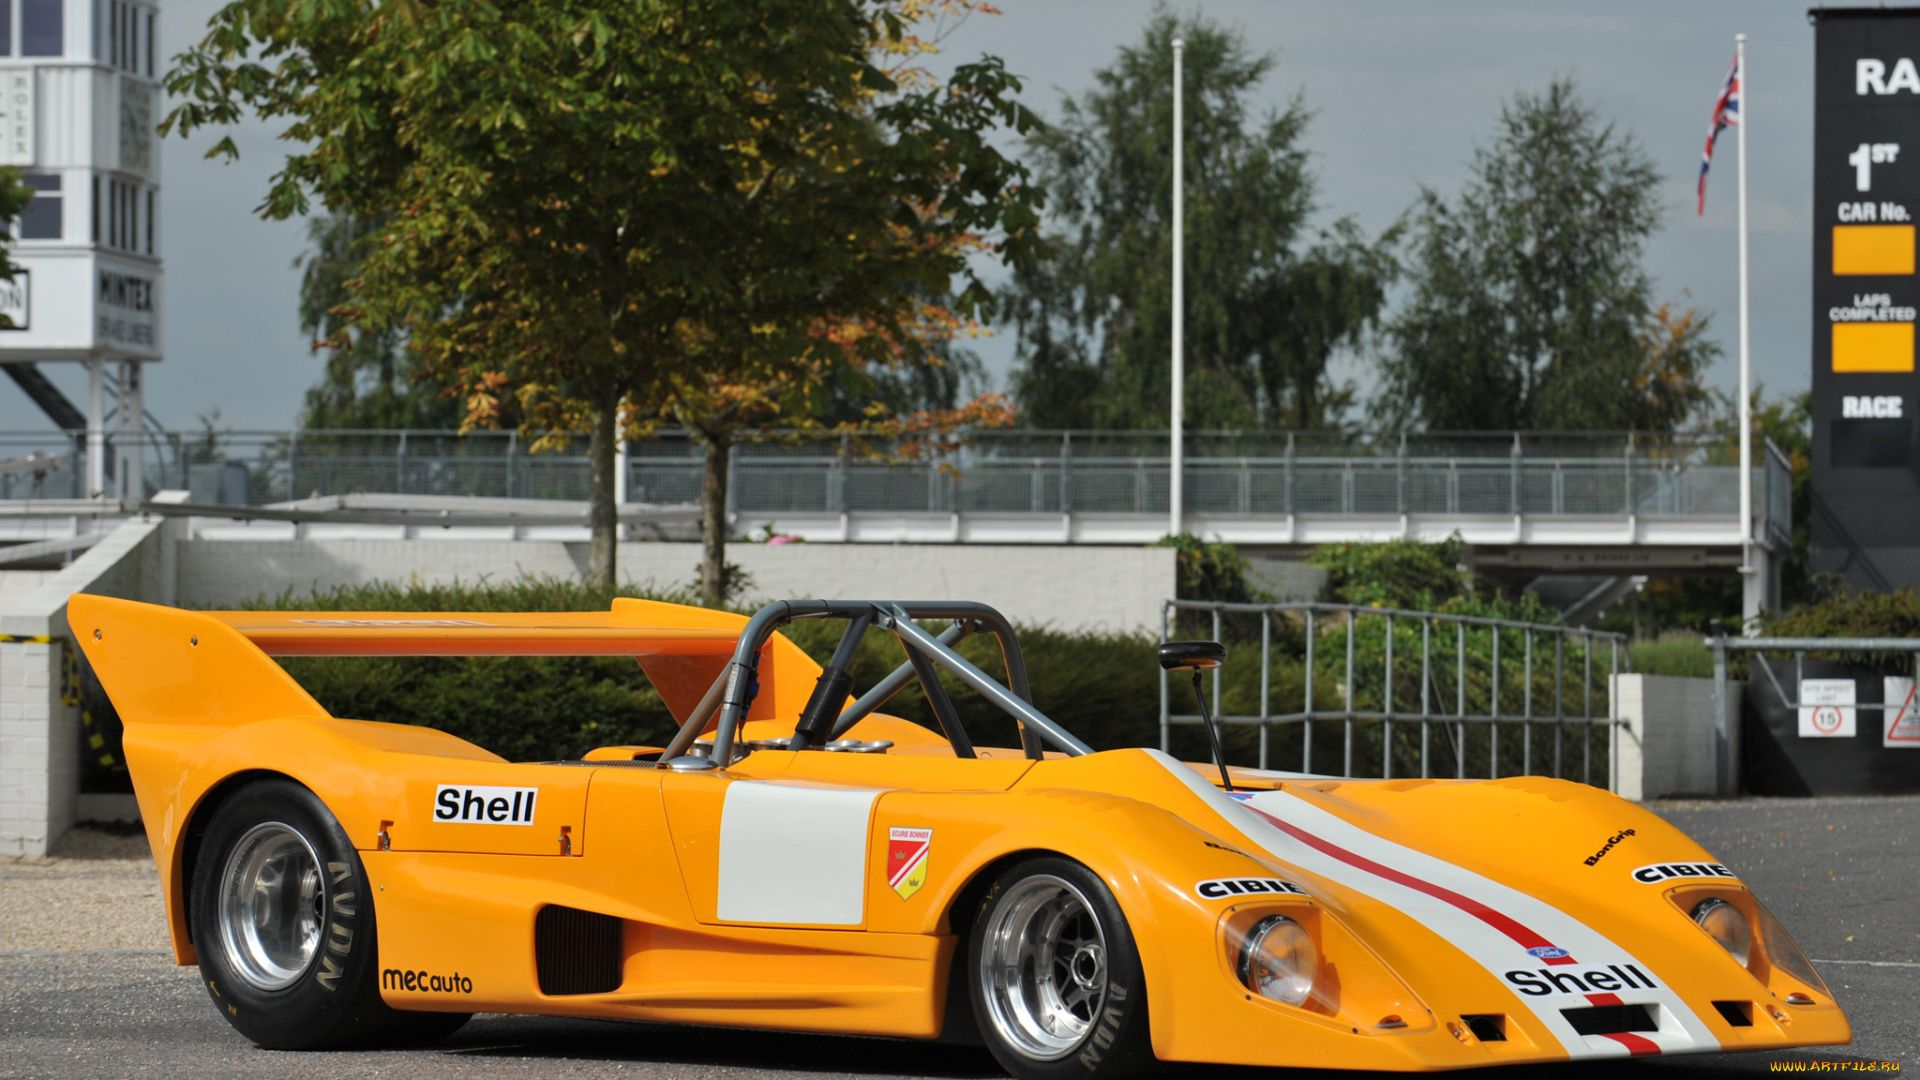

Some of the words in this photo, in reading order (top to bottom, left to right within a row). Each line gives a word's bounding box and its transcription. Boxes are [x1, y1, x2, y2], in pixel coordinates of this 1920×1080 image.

[1856, 58, 1920, 95] RA
[1849, 143, 1900, 191] 1ST
[1838, 202, 1876, 222] CAR
[1880, 202, 1911, 221] No.
[99, 269, 154, 312] MINTEX
[1853, 294, 1891, 307] LAPS
[1829, 307, 1916, 321] COMPLETED
[1842, 396, 1903, 418] RACE
[1820, 712, 1836, 725] 15
[435, 788, 535, 822] Shell
[892, 829, 909, 838] ECURIE
[1583, 828, 1636, 867] BonGrip
[1634, 864, 1735, 883] CIBIE
[1198, 879, 1308, 897] CIBIE
[315, 861, 357, 992] AVON
[1534, 948, 1562, 957] Ford
[1505, 964, 1658, 996] Shell
[1079, 982, 1127, 1072] AVON
